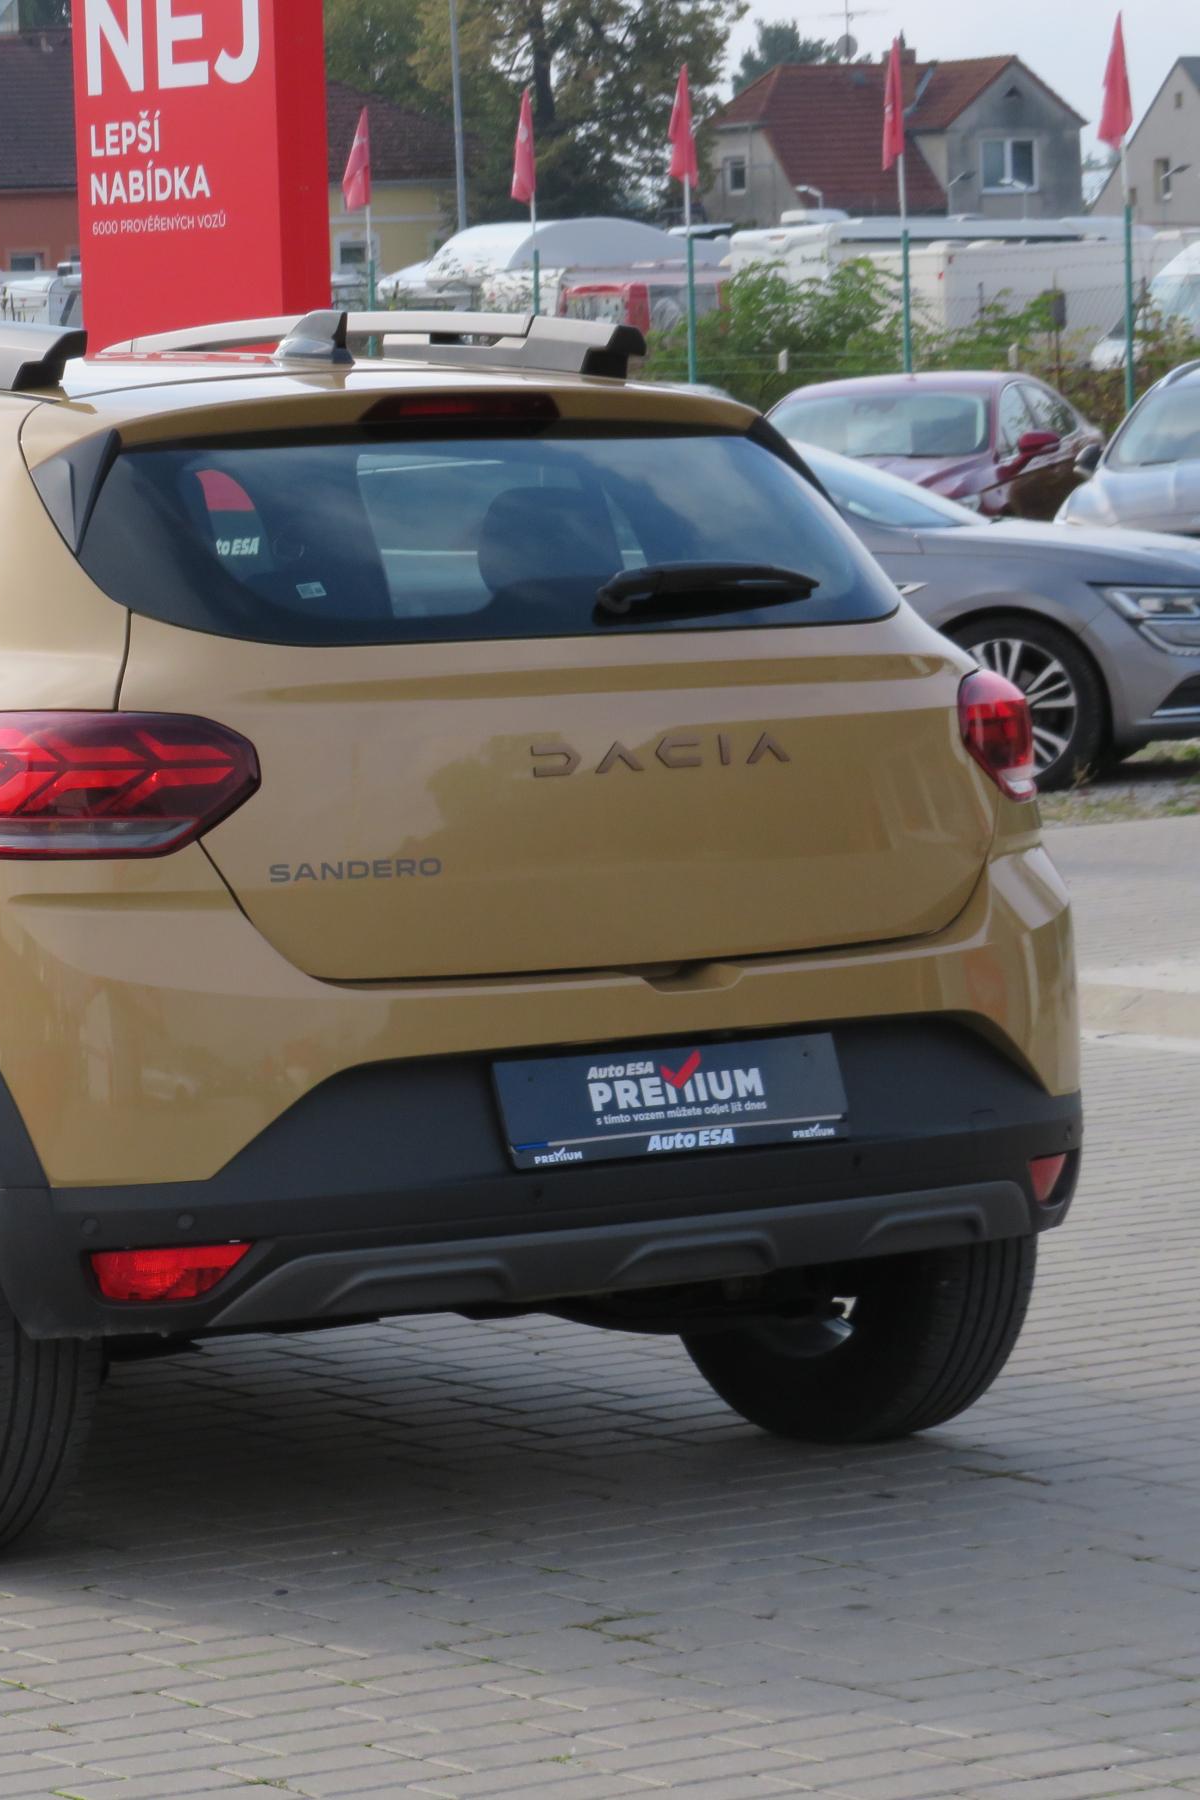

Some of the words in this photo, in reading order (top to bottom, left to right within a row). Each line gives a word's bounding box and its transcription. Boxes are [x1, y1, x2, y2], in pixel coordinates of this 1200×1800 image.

[85, 0, 260, 96] NEJ
[90, 110, 161, 157] LEPŠÍ
[90, 160, 211, 206] NABÍDKA
[92, 220, 118, 236] 6000
[120, 212, 195, 233] PROVĚŘENÝCH
[197, 209, 227, 229] VOZŮ
[231, 537, 260, 555] ESA
[529, 732, 790, 778] DACIA
[269, 857, 443, 883] SANDERO
[587, 1063, 625, 1080] Auto
[626, 1061, 655, 1075] ESA
[588, 1067, 765, 1112] PREMIUM
[632, 1111, 665, 1121] vozem
[744, 1100, 768, 1111] dnes
[647, 1132, 697, 1152] Auto
[699, 1128, 735, 1146] ESA
[534, 1148, 582, 1165] PREMIUM
